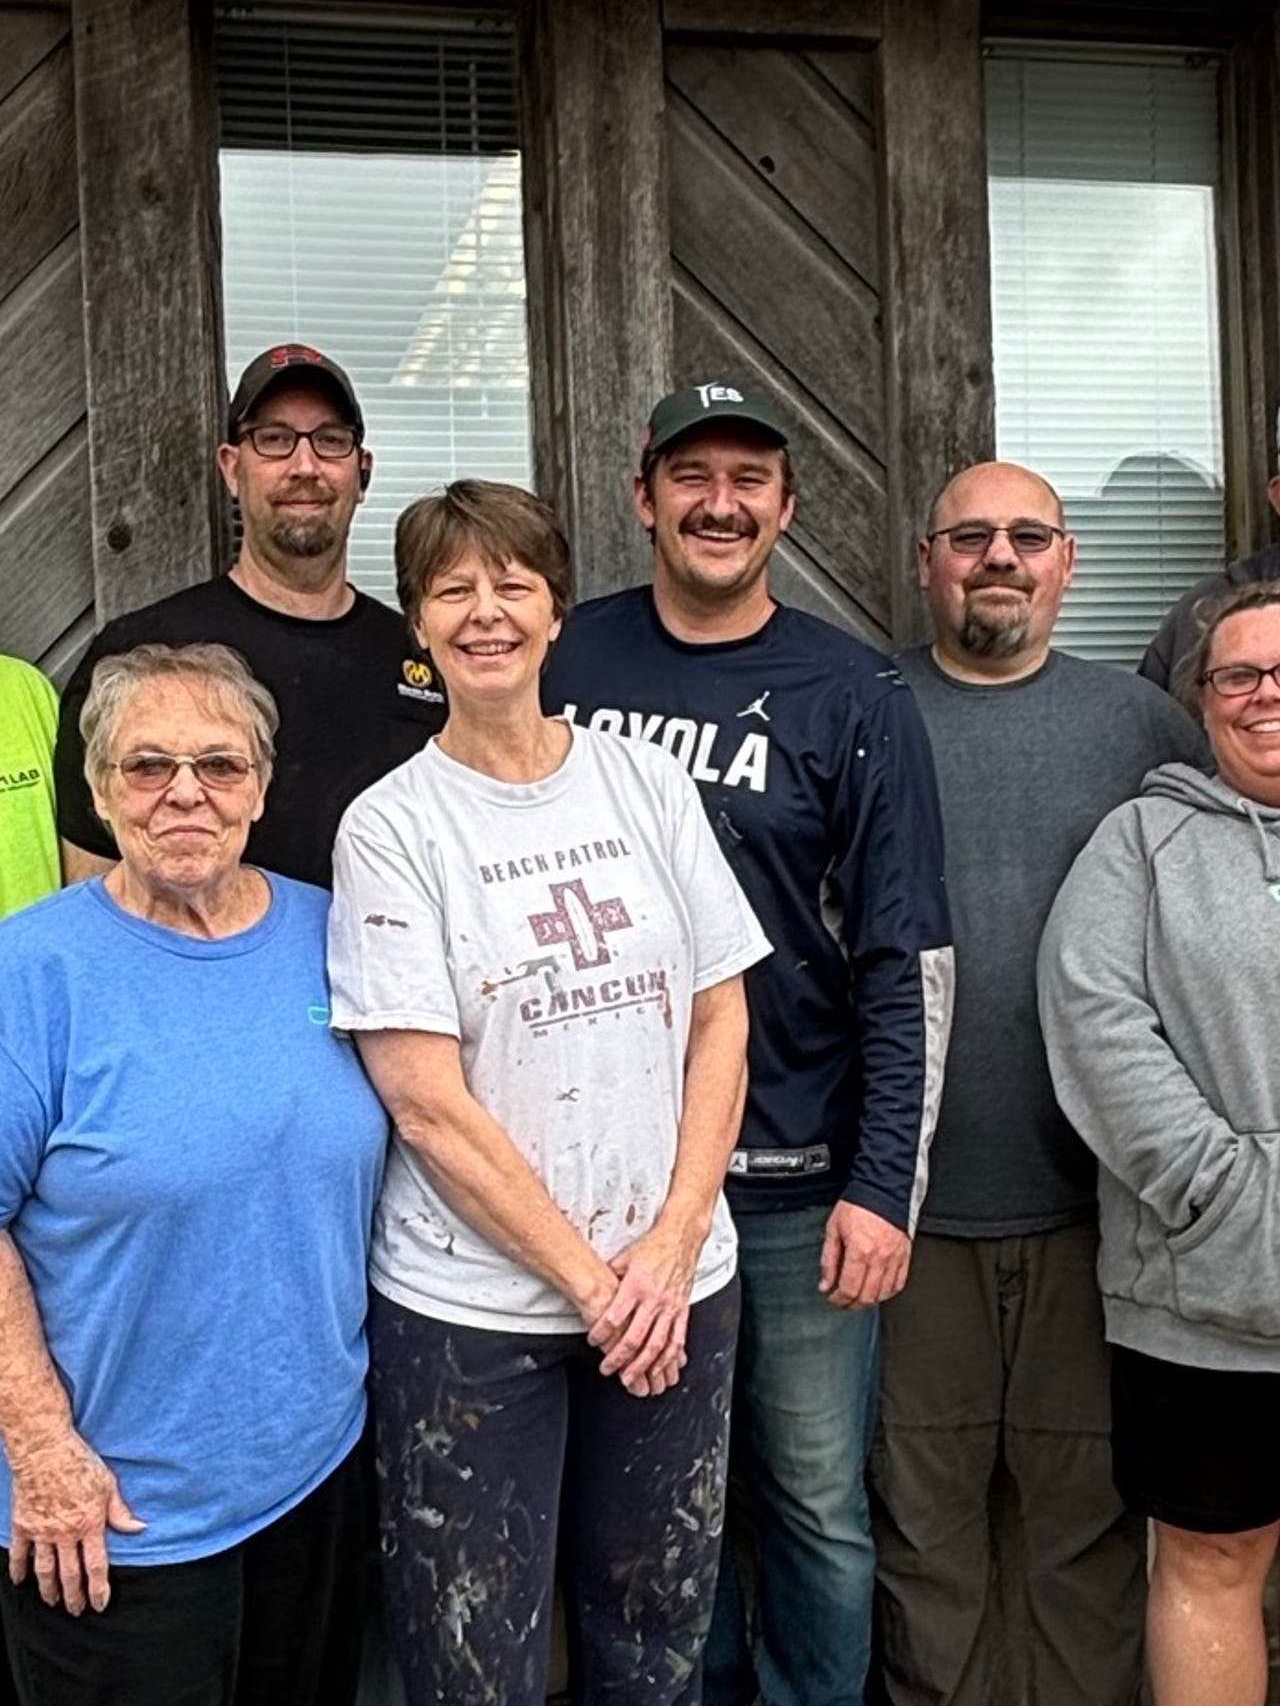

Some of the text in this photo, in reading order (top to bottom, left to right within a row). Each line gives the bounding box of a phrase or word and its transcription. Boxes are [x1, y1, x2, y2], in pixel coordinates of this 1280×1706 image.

[479, 837, 631, 885] BEACH PATROL
[519, 970, 667, 1023] CANCUN
